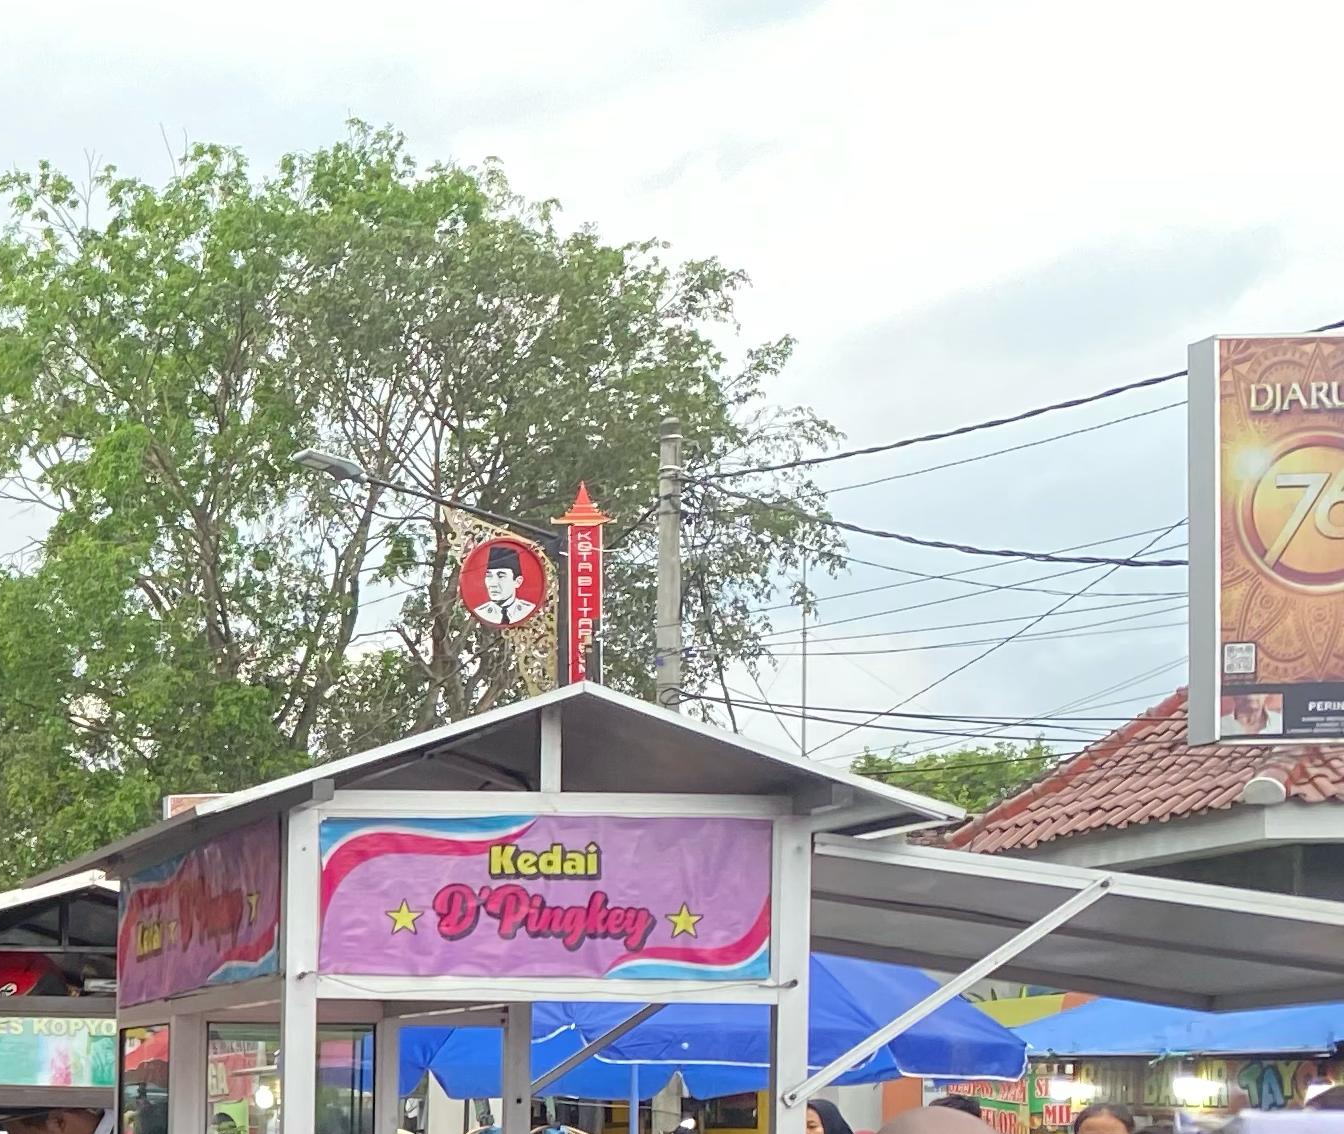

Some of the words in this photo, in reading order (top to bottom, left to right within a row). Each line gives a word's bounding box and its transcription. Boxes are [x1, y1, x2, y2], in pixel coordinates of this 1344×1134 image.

[1249, 381, 1344, 416] DJARU
[1263, 473, 1344, 571] 76
[489, 842, 602, 880] Kedai
[433, 883, 657, 952] D'Pingkey
[32, 1017, 117, 1037] KOPYO
